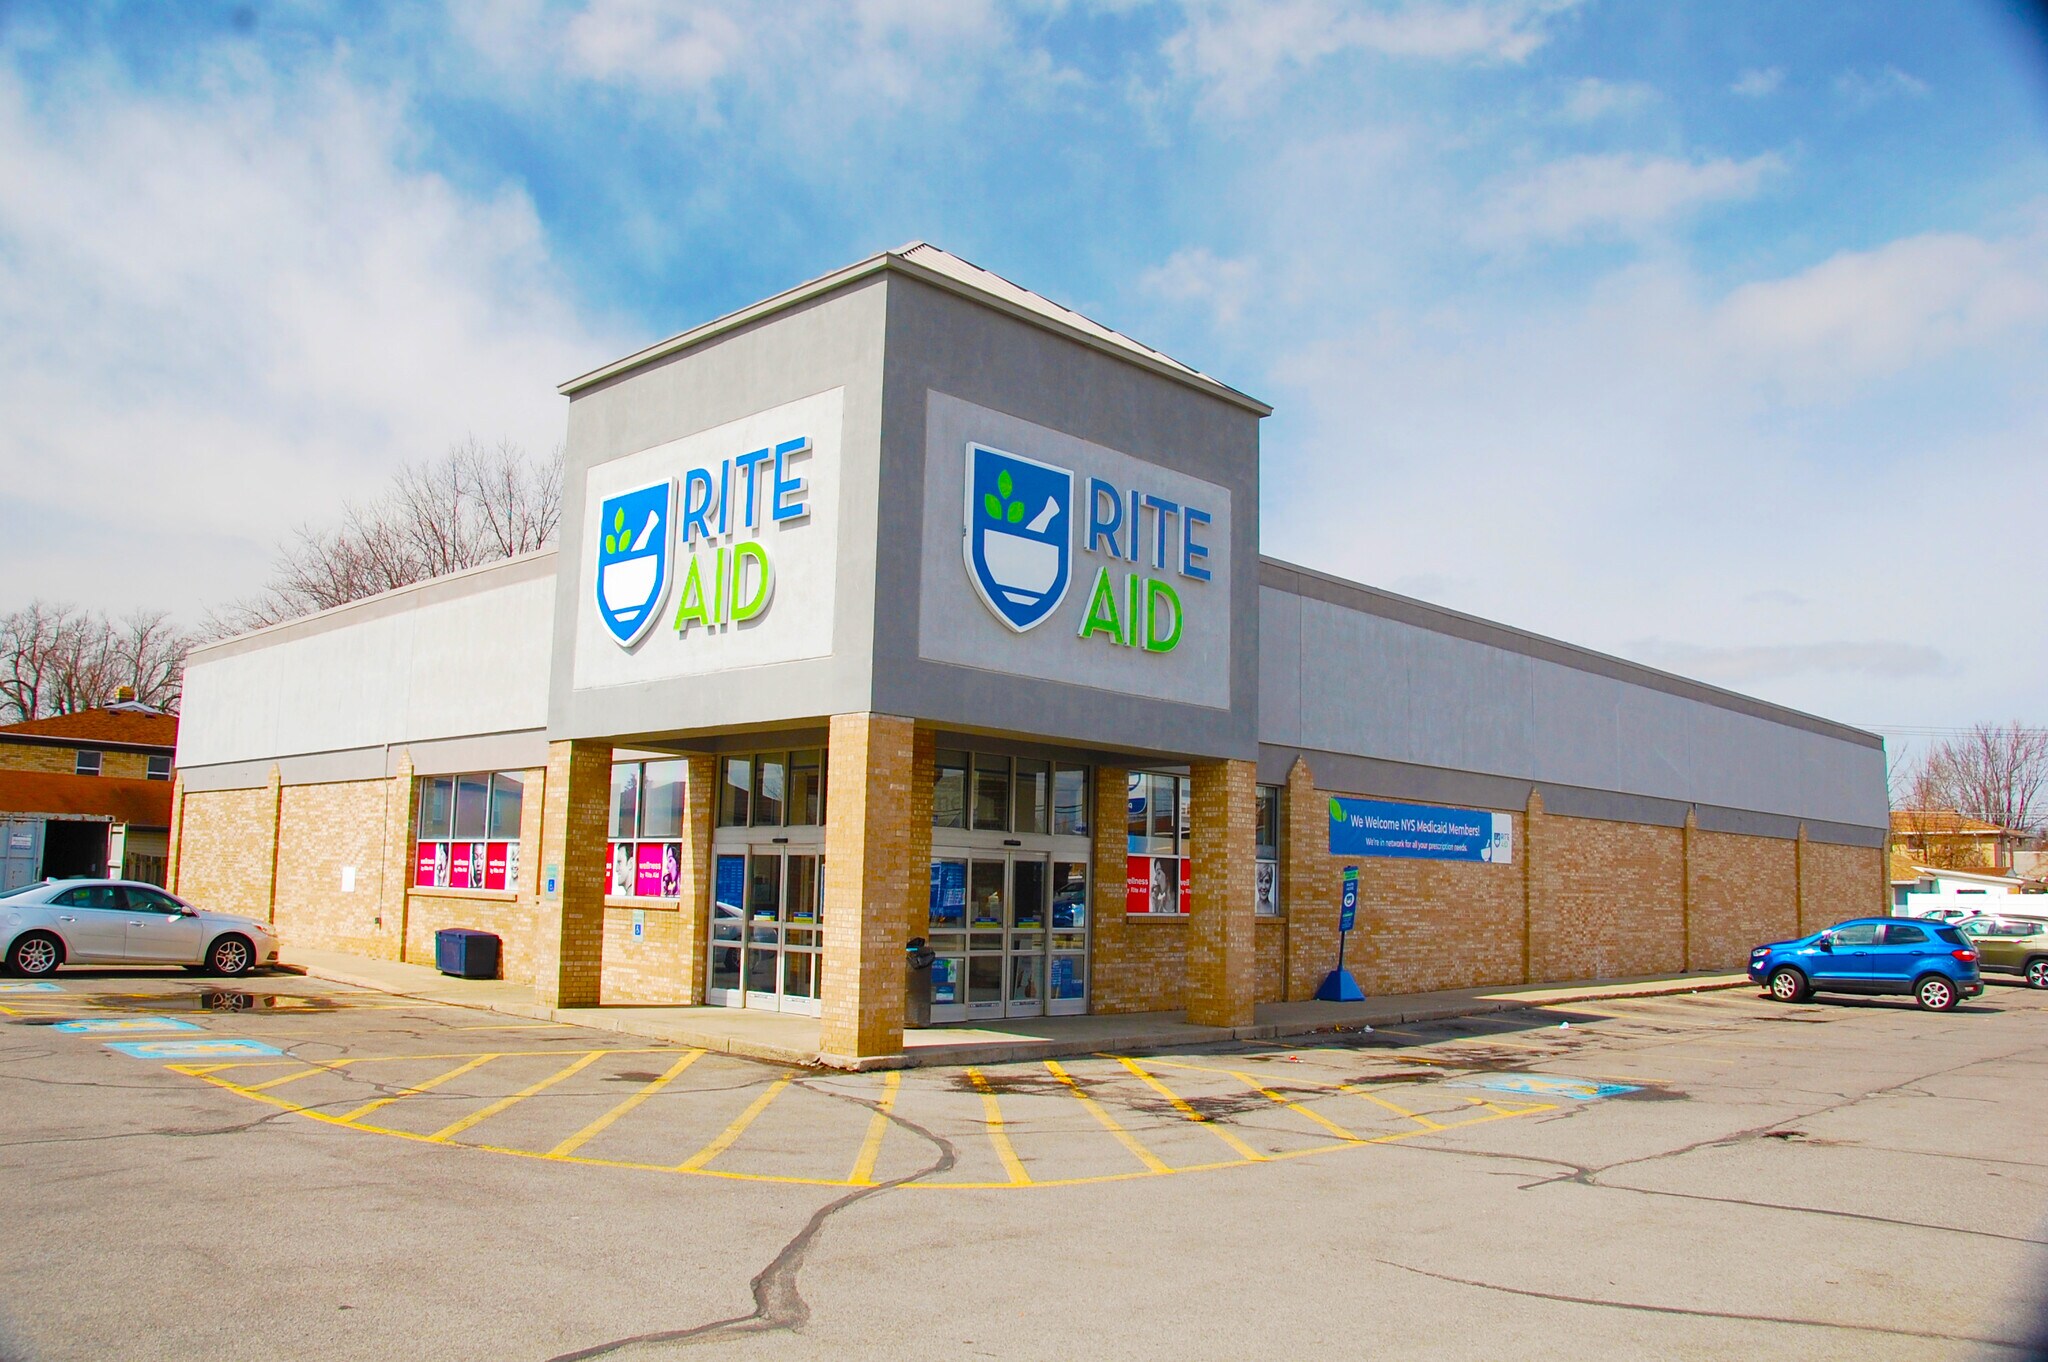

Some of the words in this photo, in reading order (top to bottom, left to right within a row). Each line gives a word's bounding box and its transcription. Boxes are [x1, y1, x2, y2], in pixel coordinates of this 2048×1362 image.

[683, 436, 812, 543] RITE
[1084, 477, 1213, 583] RITE
[673, 541, 775, 631] AID
[1078, 566, 1184, 653] AID
[639, 861, 661, 870] wellness
[1350, 814, 1364, 828] We
[1365, 815, 1400, 831] Welcome
[1401, 818, 1416, 832] NYS
[1416, 819, 1448, 834] Medicaid
[1448, 822, 1480, 837] Members!
[1365, 836, 1380, 847] We're
[1386, 839, 1405, 848] network
[1417, 842, 1428, 851] your
[1428, 842, 1454, 852] prescription
